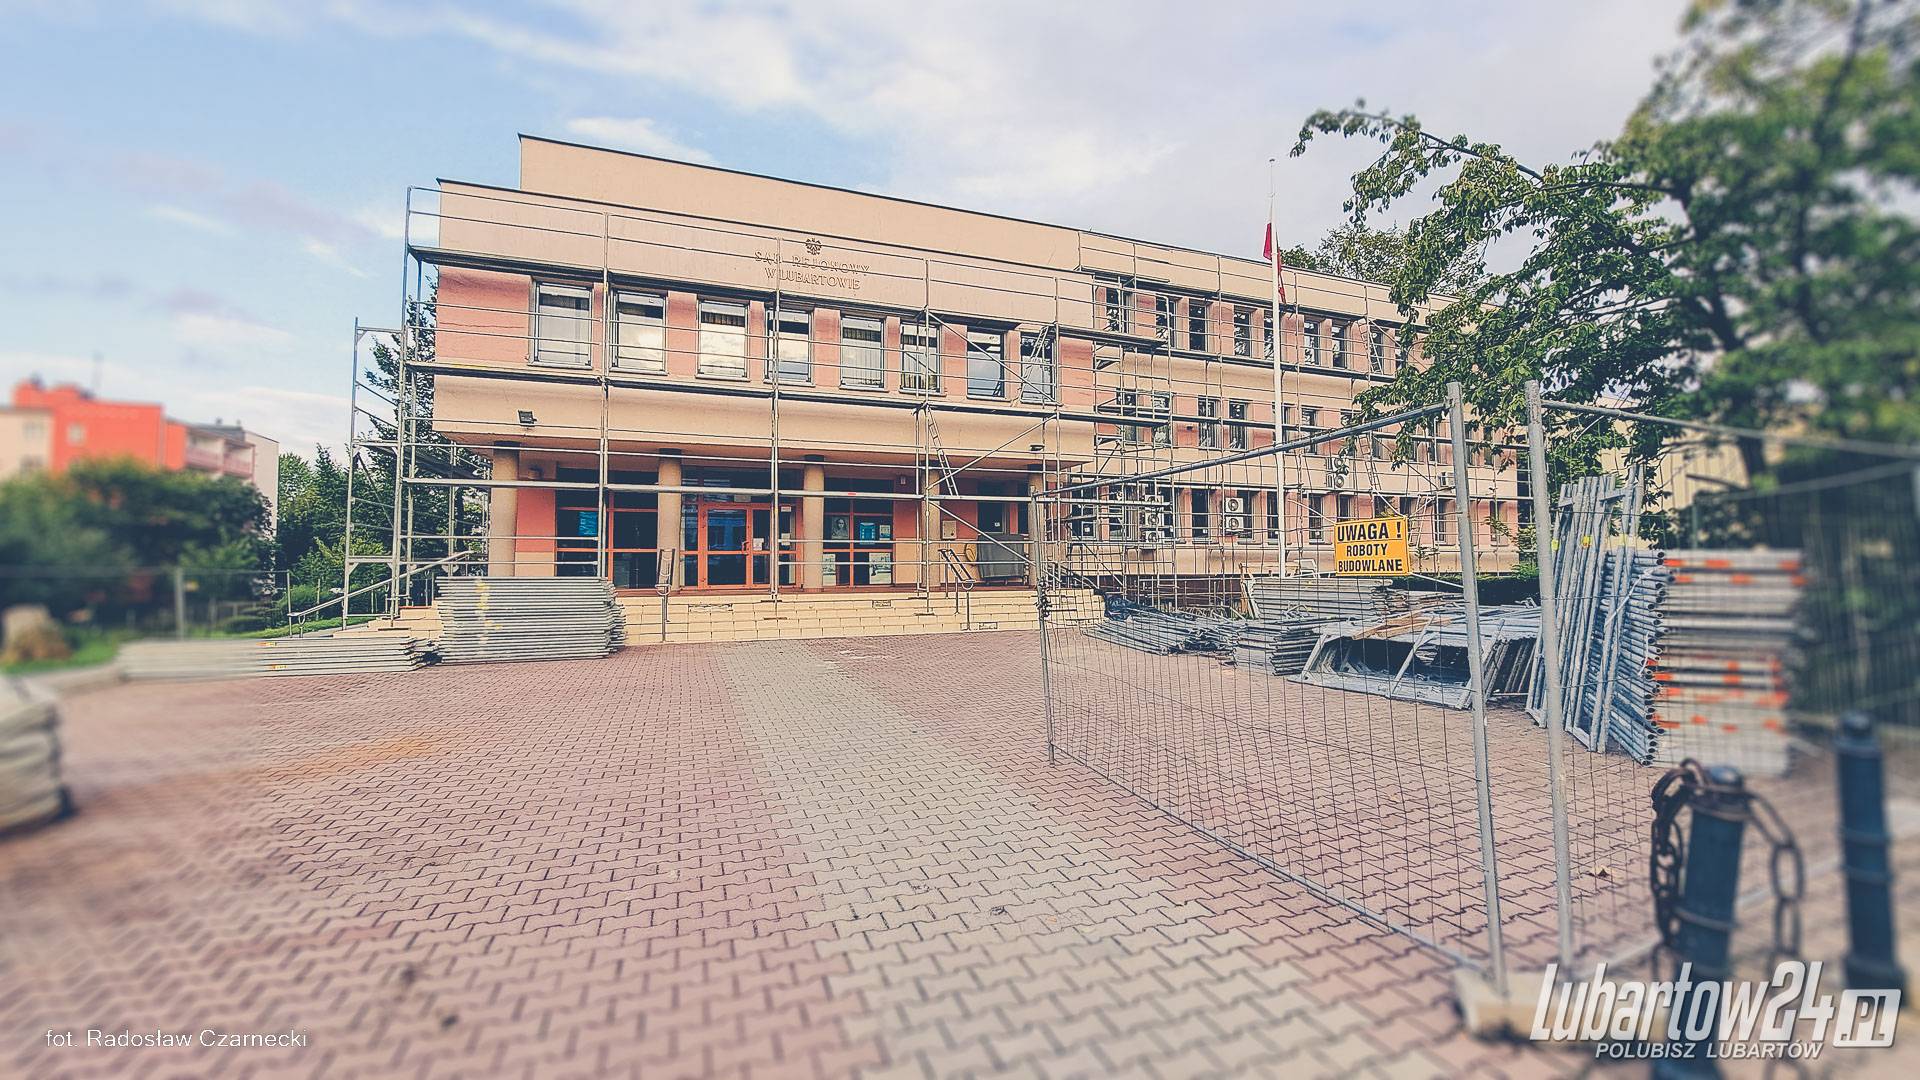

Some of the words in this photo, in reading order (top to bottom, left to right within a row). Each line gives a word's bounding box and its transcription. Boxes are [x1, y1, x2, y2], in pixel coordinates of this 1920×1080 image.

[779, 269, 861, 290] LUBARTOWIE
[1337, 522, 1389, 541] UWAGA
[1346, 543, 1388, 557] ROBOTY
[1338, 559, 1403, 572] BUDOWLANE
